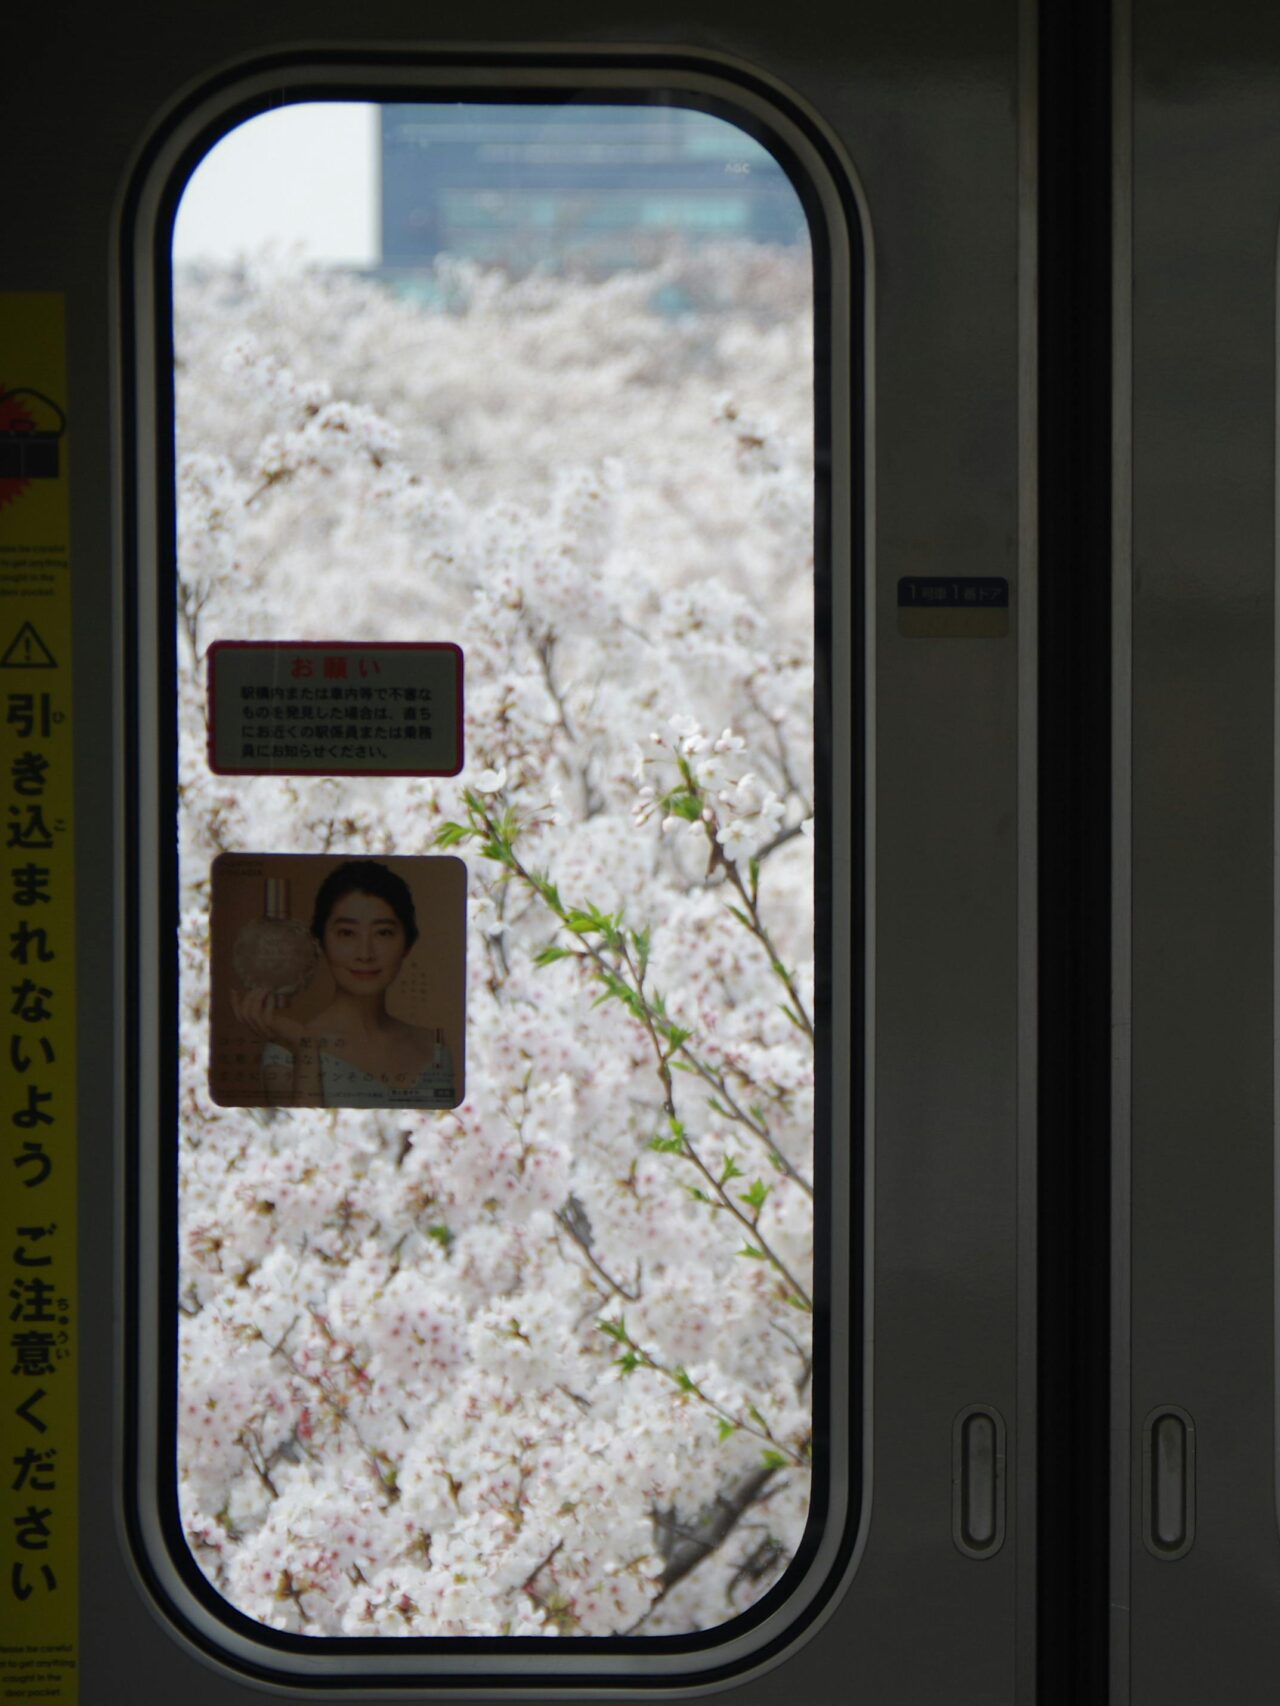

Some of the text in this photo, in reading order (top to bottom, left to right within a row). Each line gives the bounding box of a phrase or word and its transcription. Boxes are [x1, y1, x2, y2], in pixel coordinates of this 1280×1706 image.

[290, 655, 381, 679] お願い
[6, 692, 57, 1602] 引き込まれないよう ご注意ください
